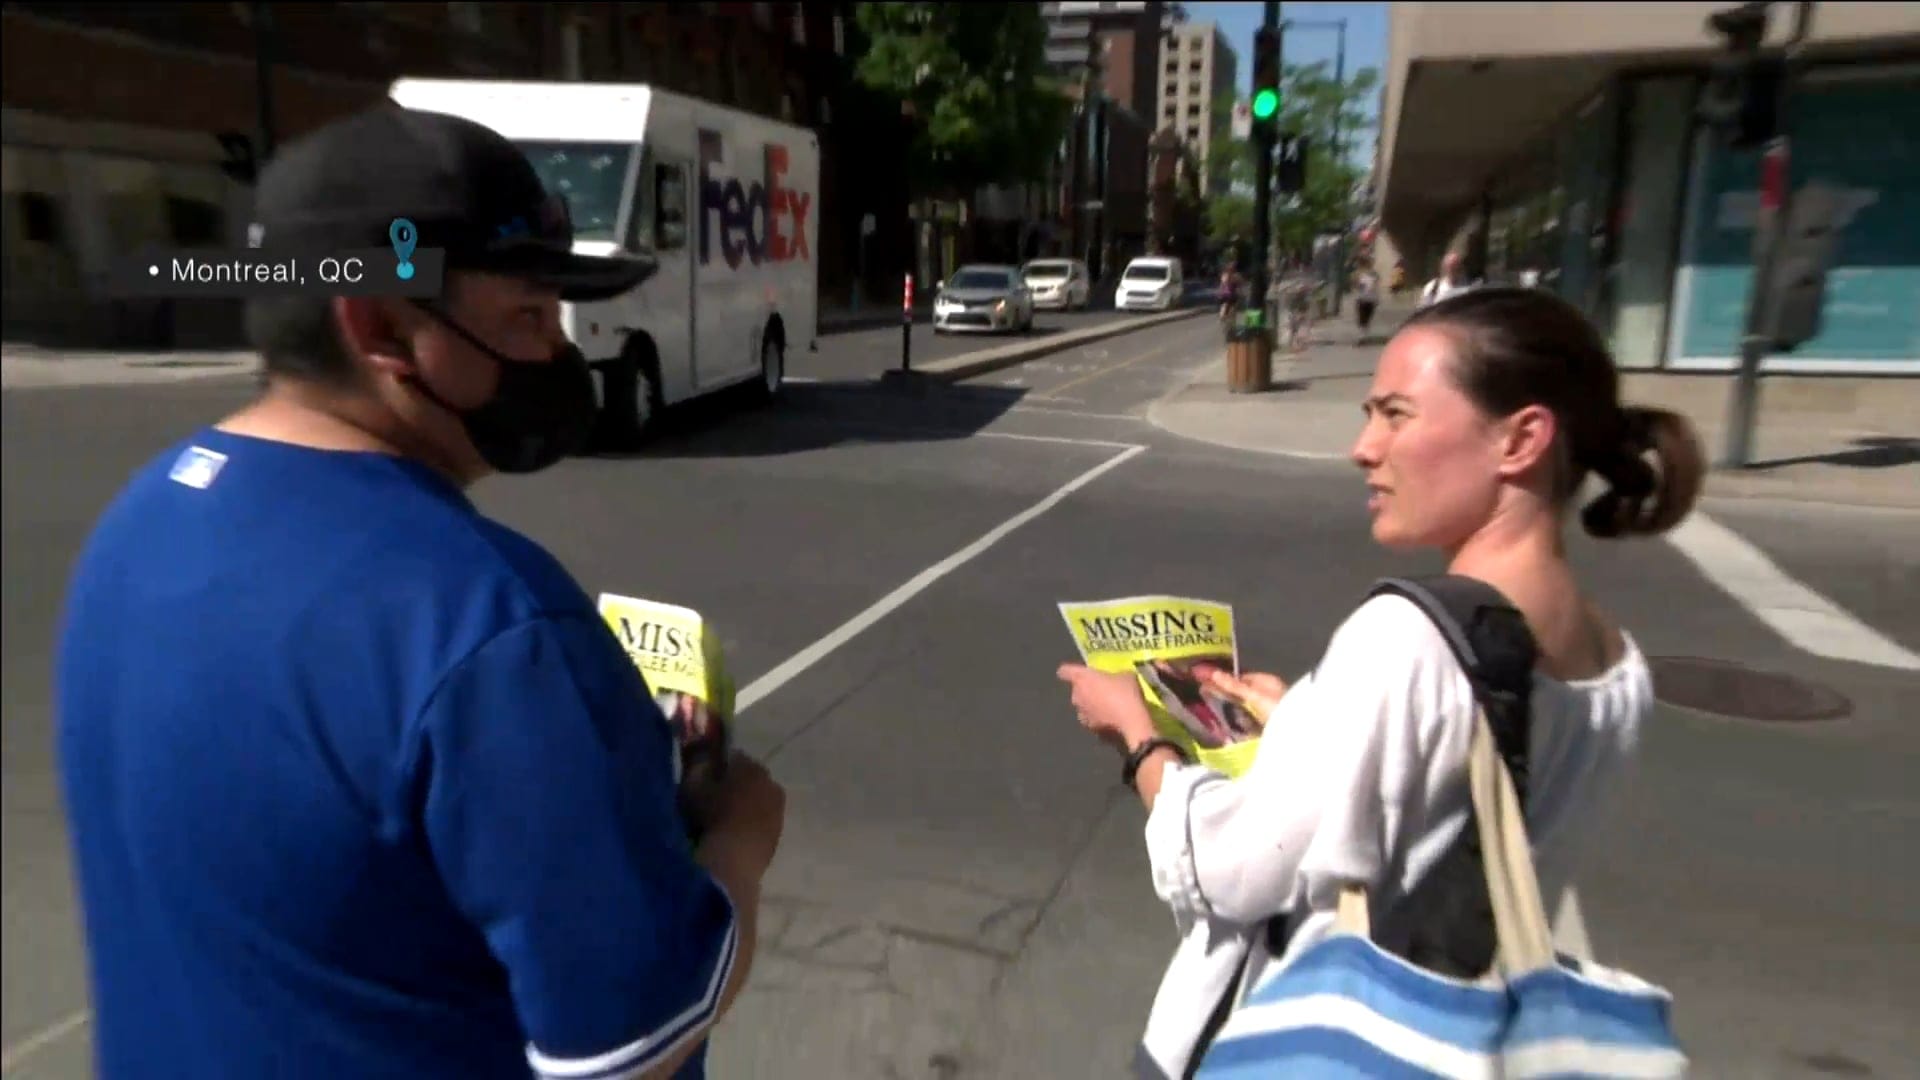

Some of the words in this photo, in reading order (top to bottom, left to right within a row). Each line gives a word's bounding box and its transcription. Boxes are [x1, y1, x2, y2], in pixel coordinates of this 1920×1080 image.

[699, 128, 810, 271] FedEx
[1080, 610, 1214, 640] MISSING
[1131, 637, 1160, 650] MAE
